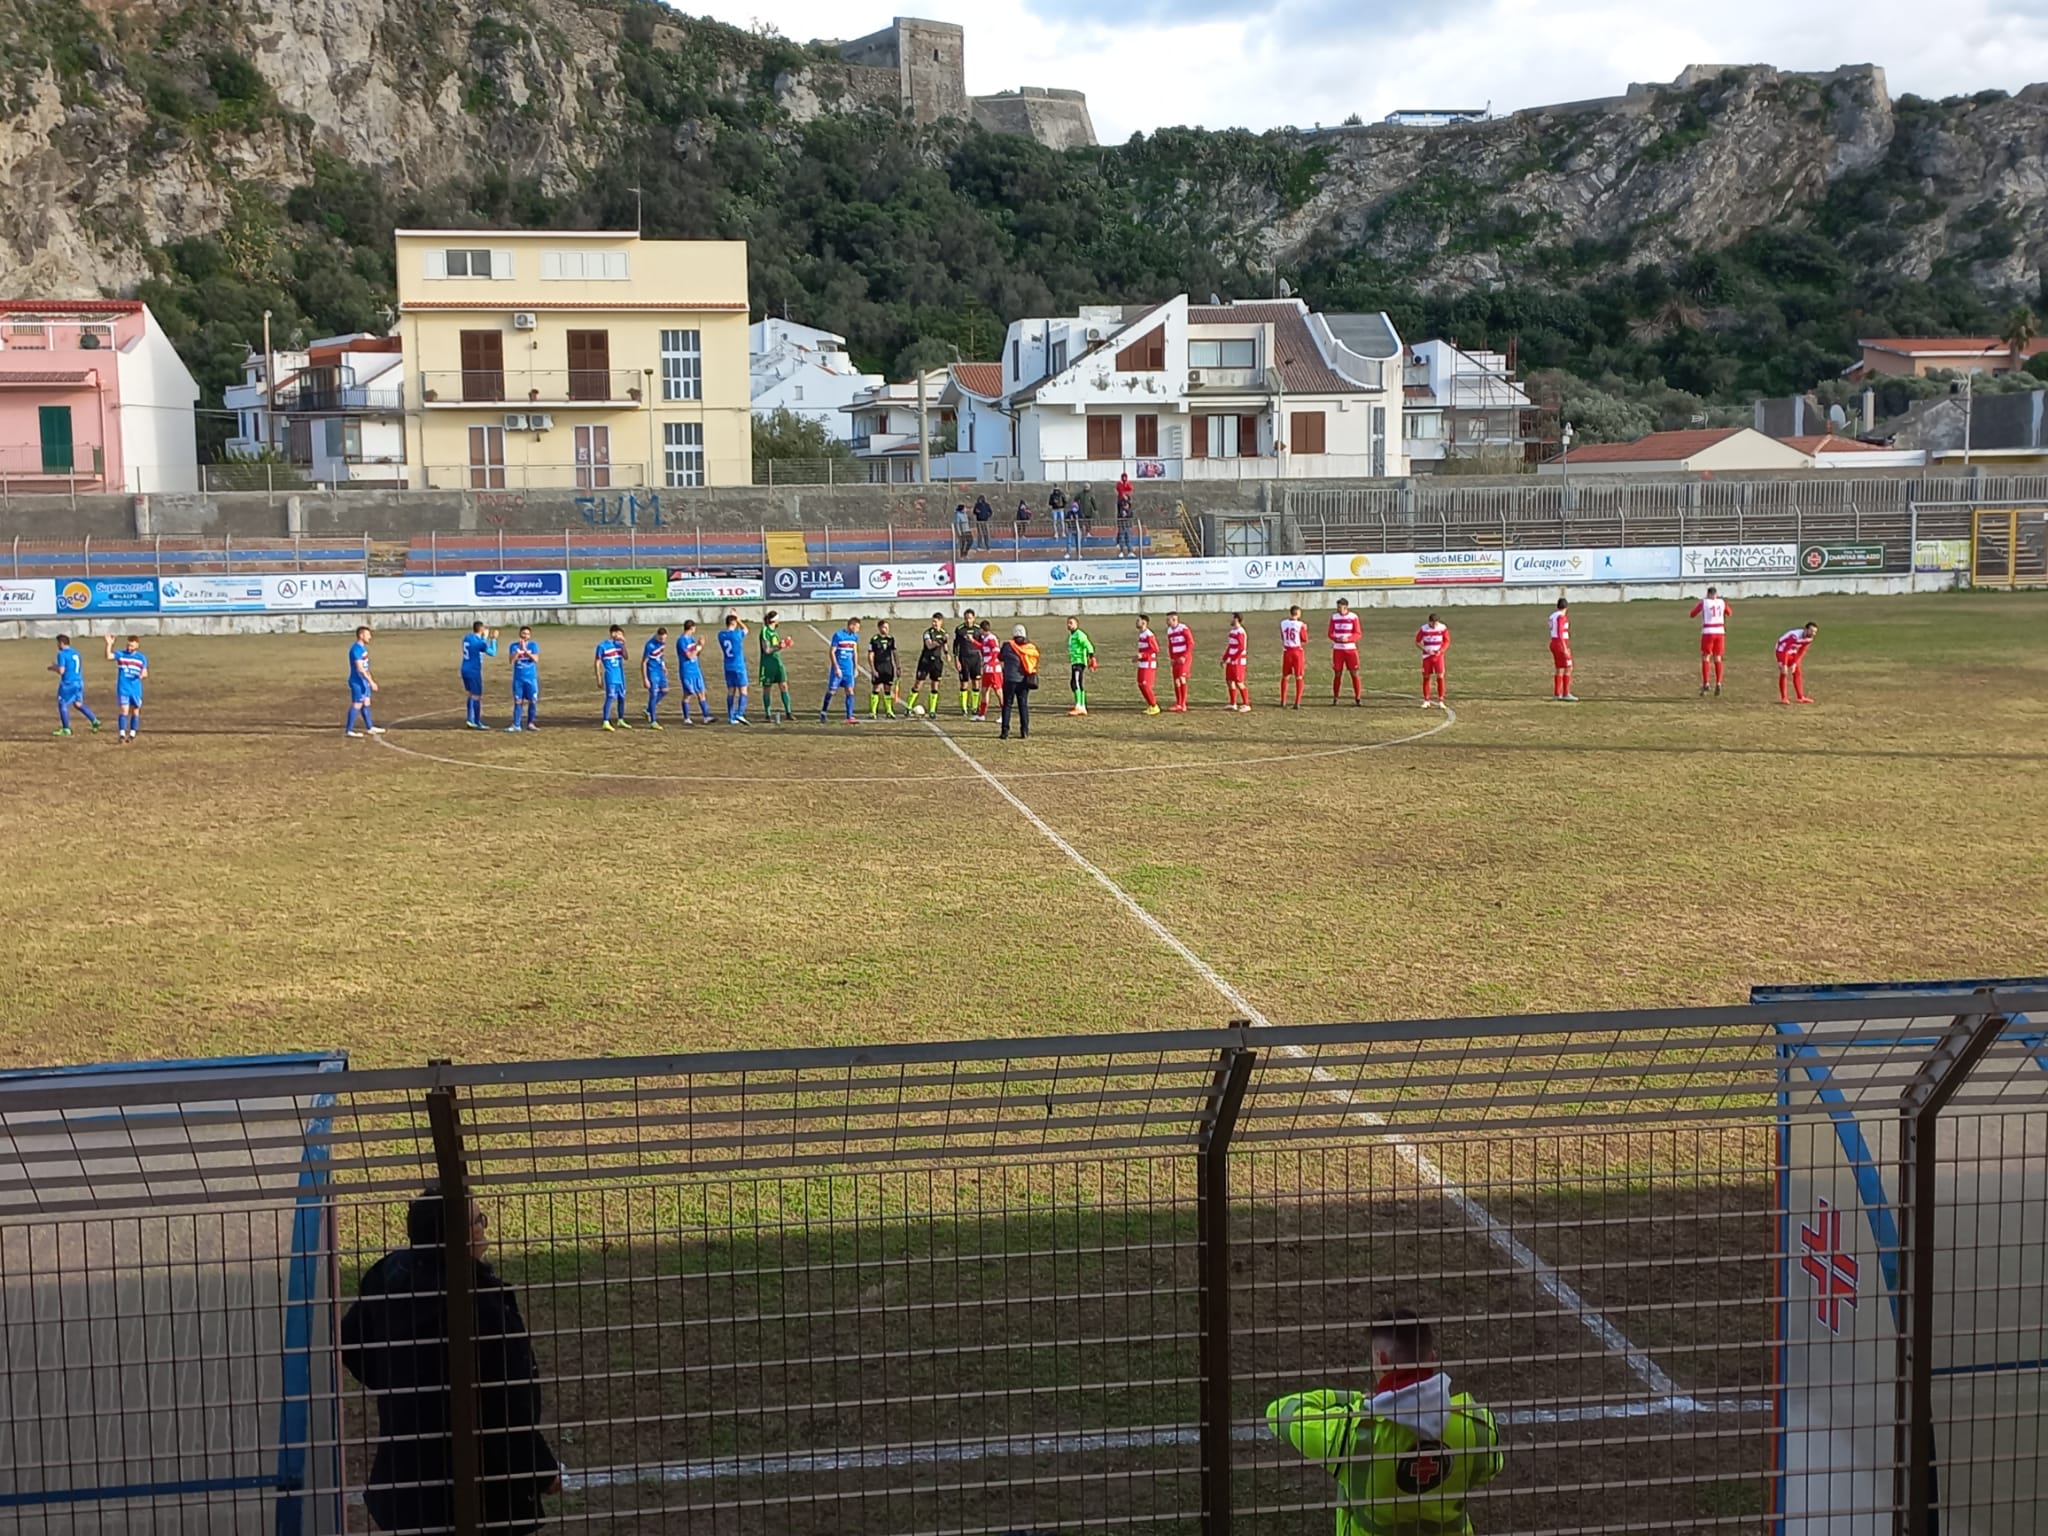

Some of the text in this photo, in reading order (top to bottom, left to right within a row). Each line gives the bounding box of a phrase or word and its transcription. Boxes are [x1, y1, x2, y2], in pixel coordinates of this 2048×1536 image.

[1714, 547, 1785, 556] FARMACIA
[1418, 554, 1492, 563] Studio MEDILAV
[1514, 556, 1567, 571] Calcagno
[1704, 556, 1796, 568] MANICASTRI
[1265, 560, 1305, 571] FIMA
[800, 570, 844, 582] FIMA
[300, 579, 347, 591] FIMA
[12, 592, 35, 601] FIGLI
[1710, 606, 1722, 617] 11
[1284, 627, 1296, 641] 16
[463, 642, 470, 660] 5
[723, 640, 734, 658] 2
